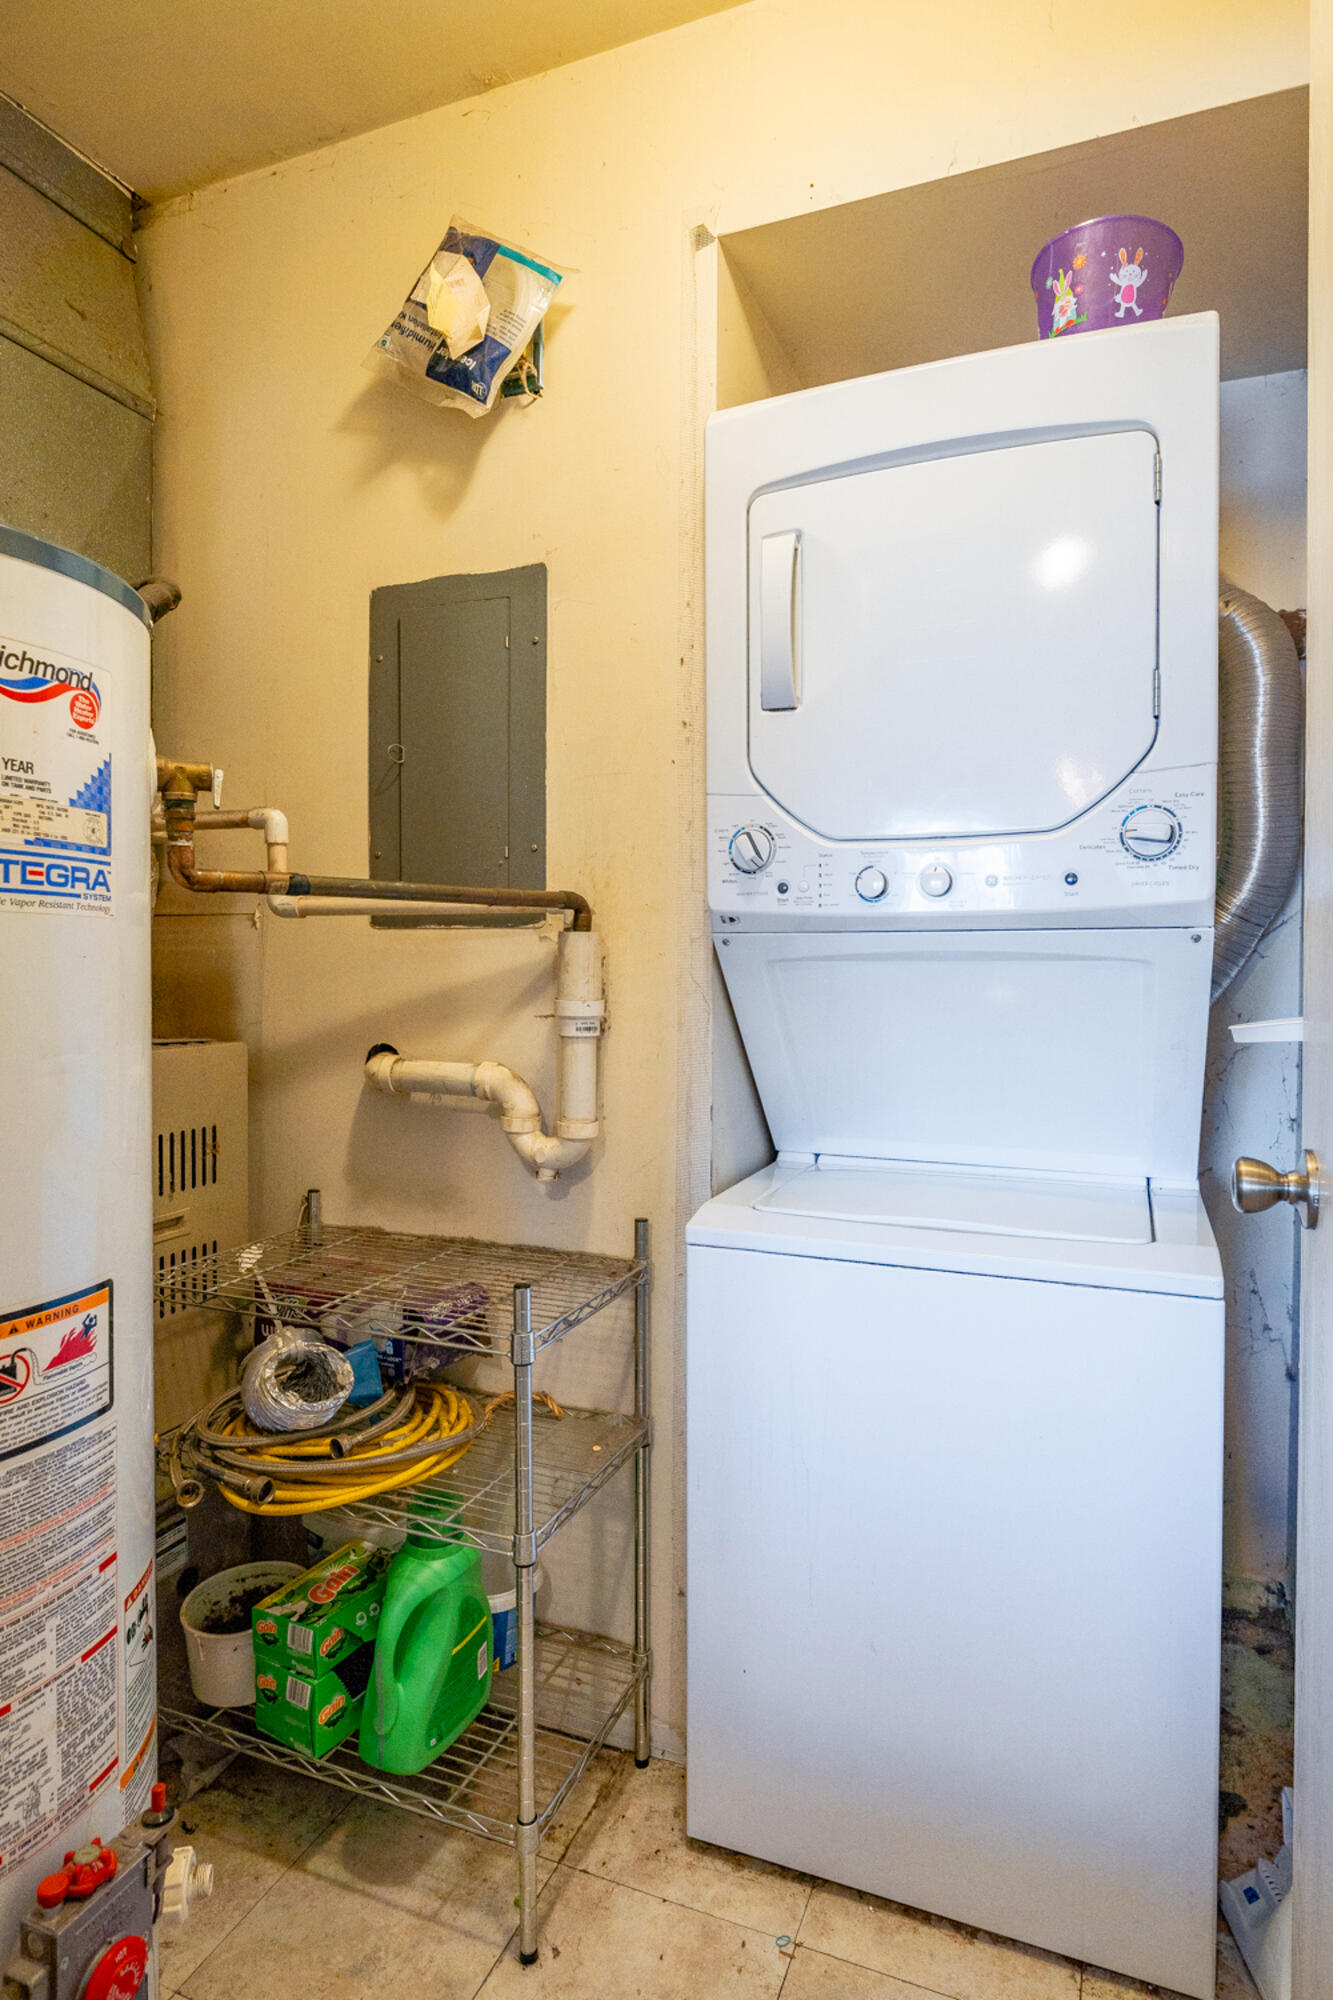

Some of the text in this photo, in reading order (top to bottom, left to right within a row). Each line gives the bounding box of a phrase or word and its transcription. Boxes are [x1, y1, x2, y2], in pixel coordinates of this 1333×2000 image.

[1, 757, 34, 775] YEAR
[9, 898, 36, 909] Vapor
[38, 900, 73, 910] Resistant
[76, 903, 110, 914] Technology
[83, 893, 112, 902] SYSTEM
[25, 1304, 80, 1329] WARNING
[308, 1564, 360, 1604] Gain
[256, 1620, 278, 1634] Gain
[320, 1627, 343, 1656] Gain
[257, 1673, 277, 1691] Gain
[319, 1694, 345, 1724] Gain
